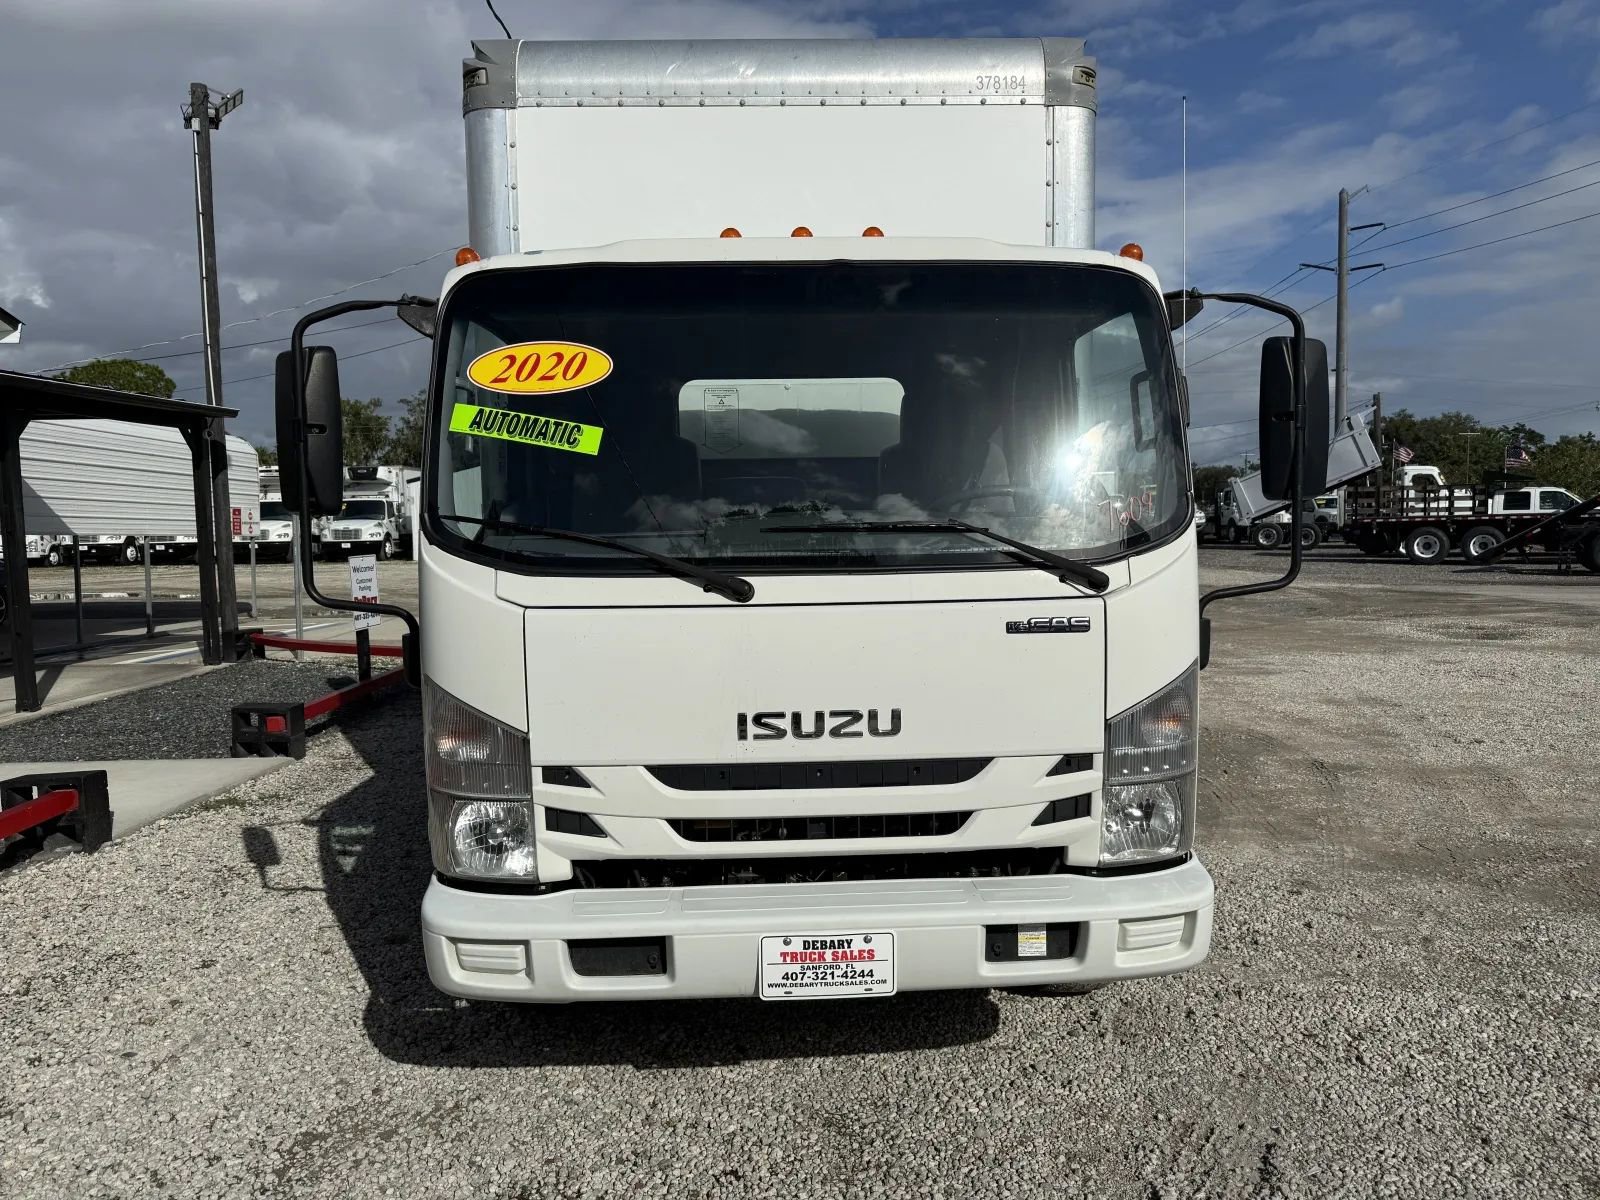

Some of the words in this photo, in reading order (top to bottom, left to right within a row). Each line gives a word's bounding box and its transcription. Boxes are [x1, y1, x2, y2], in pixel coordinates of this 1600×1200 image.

[976, 75, 1027, 90] 378184
[489, 351, 588, 384] 2020
[468, 407, 584, 449] AUTOMATIC
[352, 564, 375, 573] Welcome!
[737, 708, 902, 741] ISUZU
[802, 939, 854, 951] DEBARY
[780, 950, 827, 963] TRUCK
[831, 948, 876, 961] SALES
[781, 968, 875, 981] 407-321-4244
[800, 964, 844, 972] SANFORD,
[767, 979, 888, 989] WWW.DEBARYTRUCKSALES.COM
